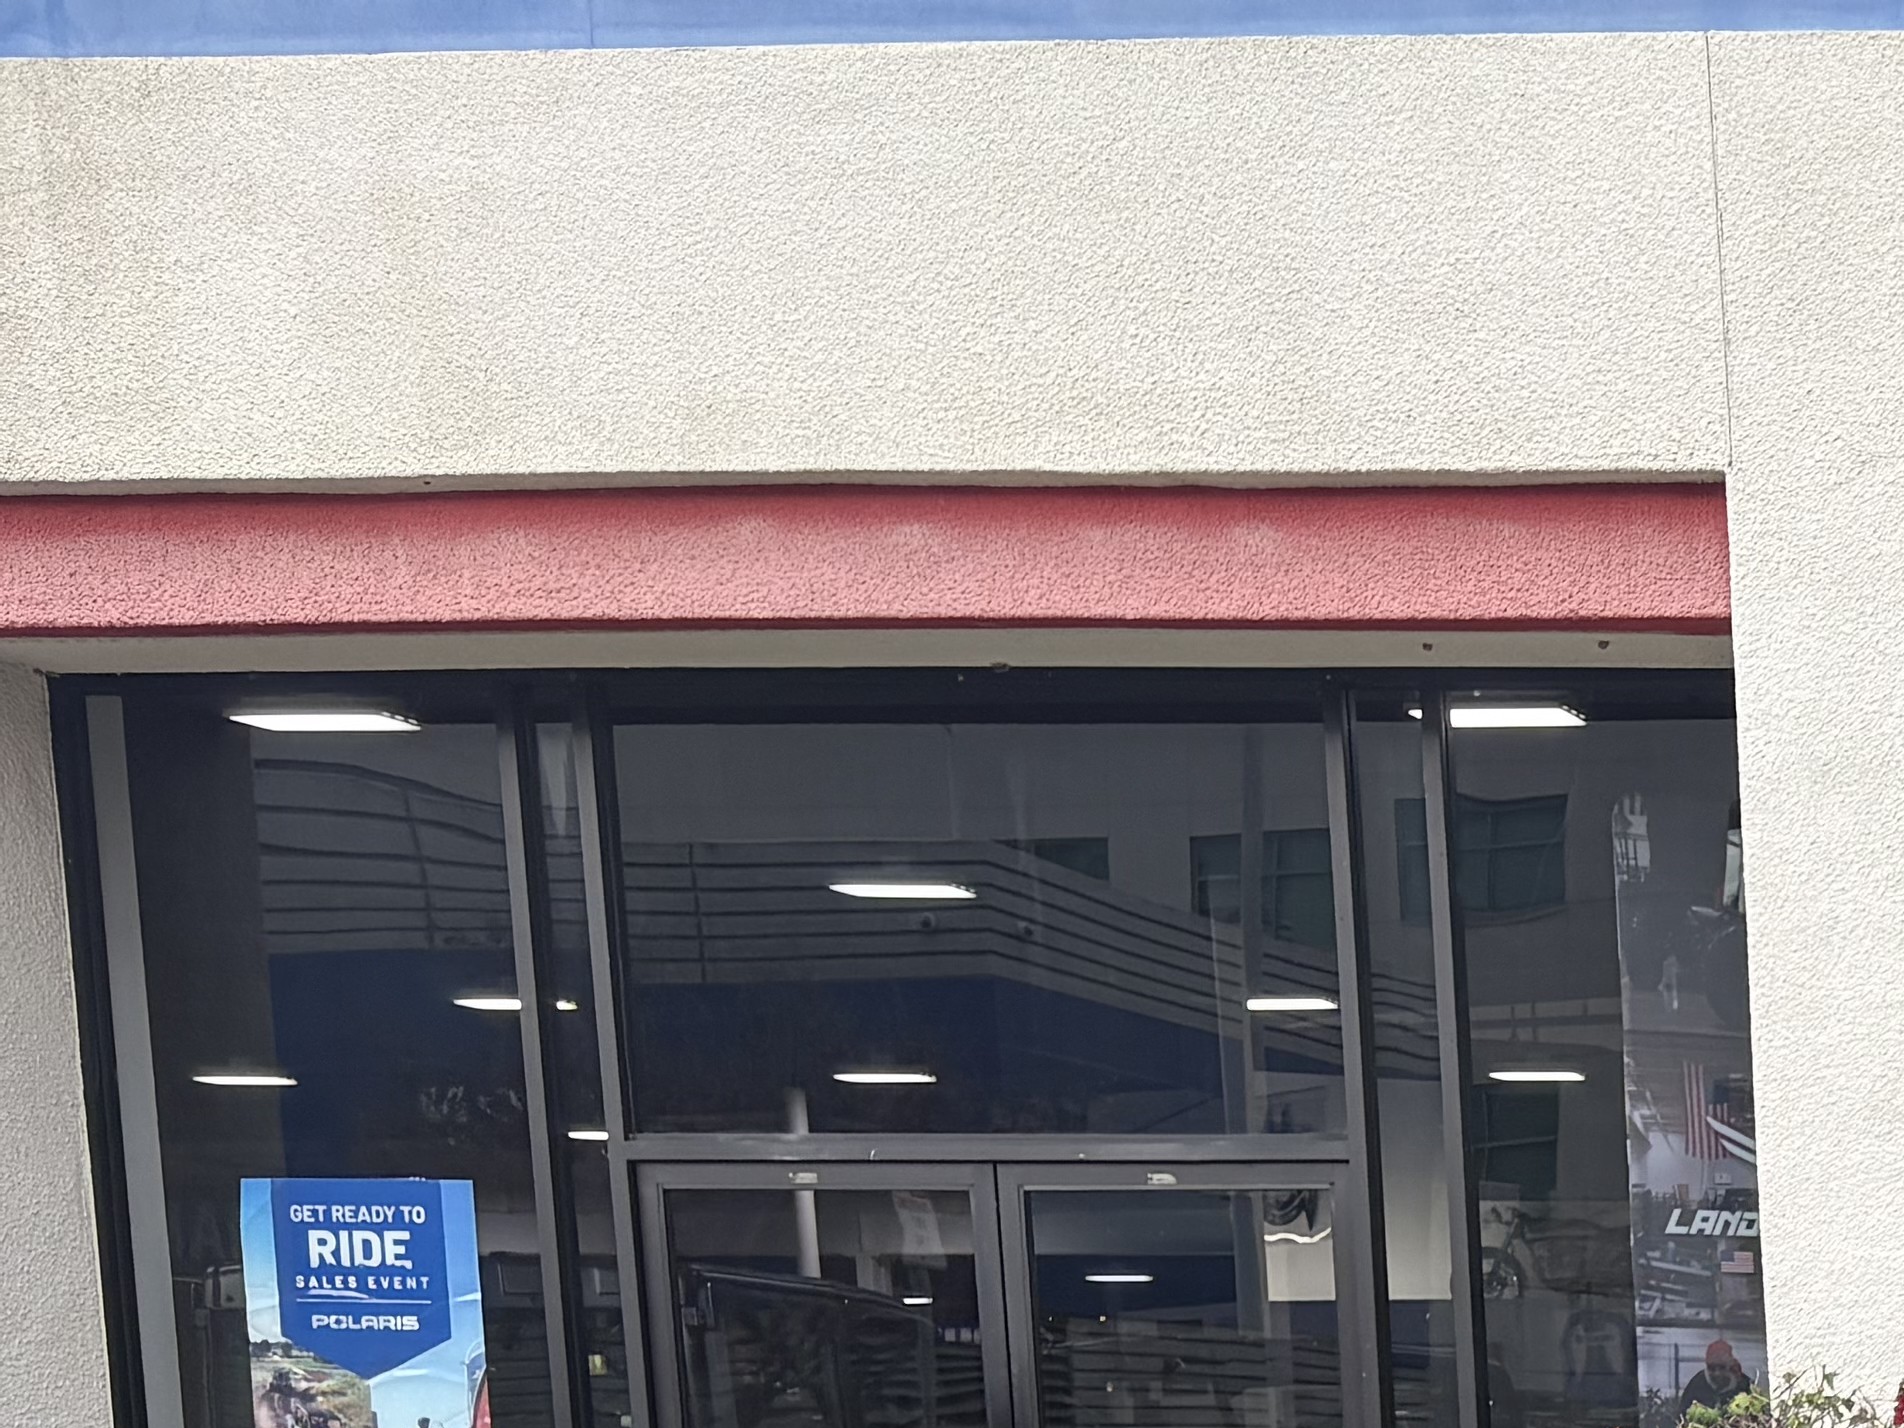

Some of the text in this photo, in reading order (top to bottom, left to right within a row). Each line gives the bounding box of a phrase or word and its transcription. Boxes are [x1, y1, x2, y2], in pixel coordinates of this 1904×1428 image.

[290, 1204, 426, 1224] GET READY TO
[308, 1229, 412, 1270] RIDE
[296, 1275, 429, 1289] SALES EVENT
[312, 1314, 419, 1331] POLARIS
